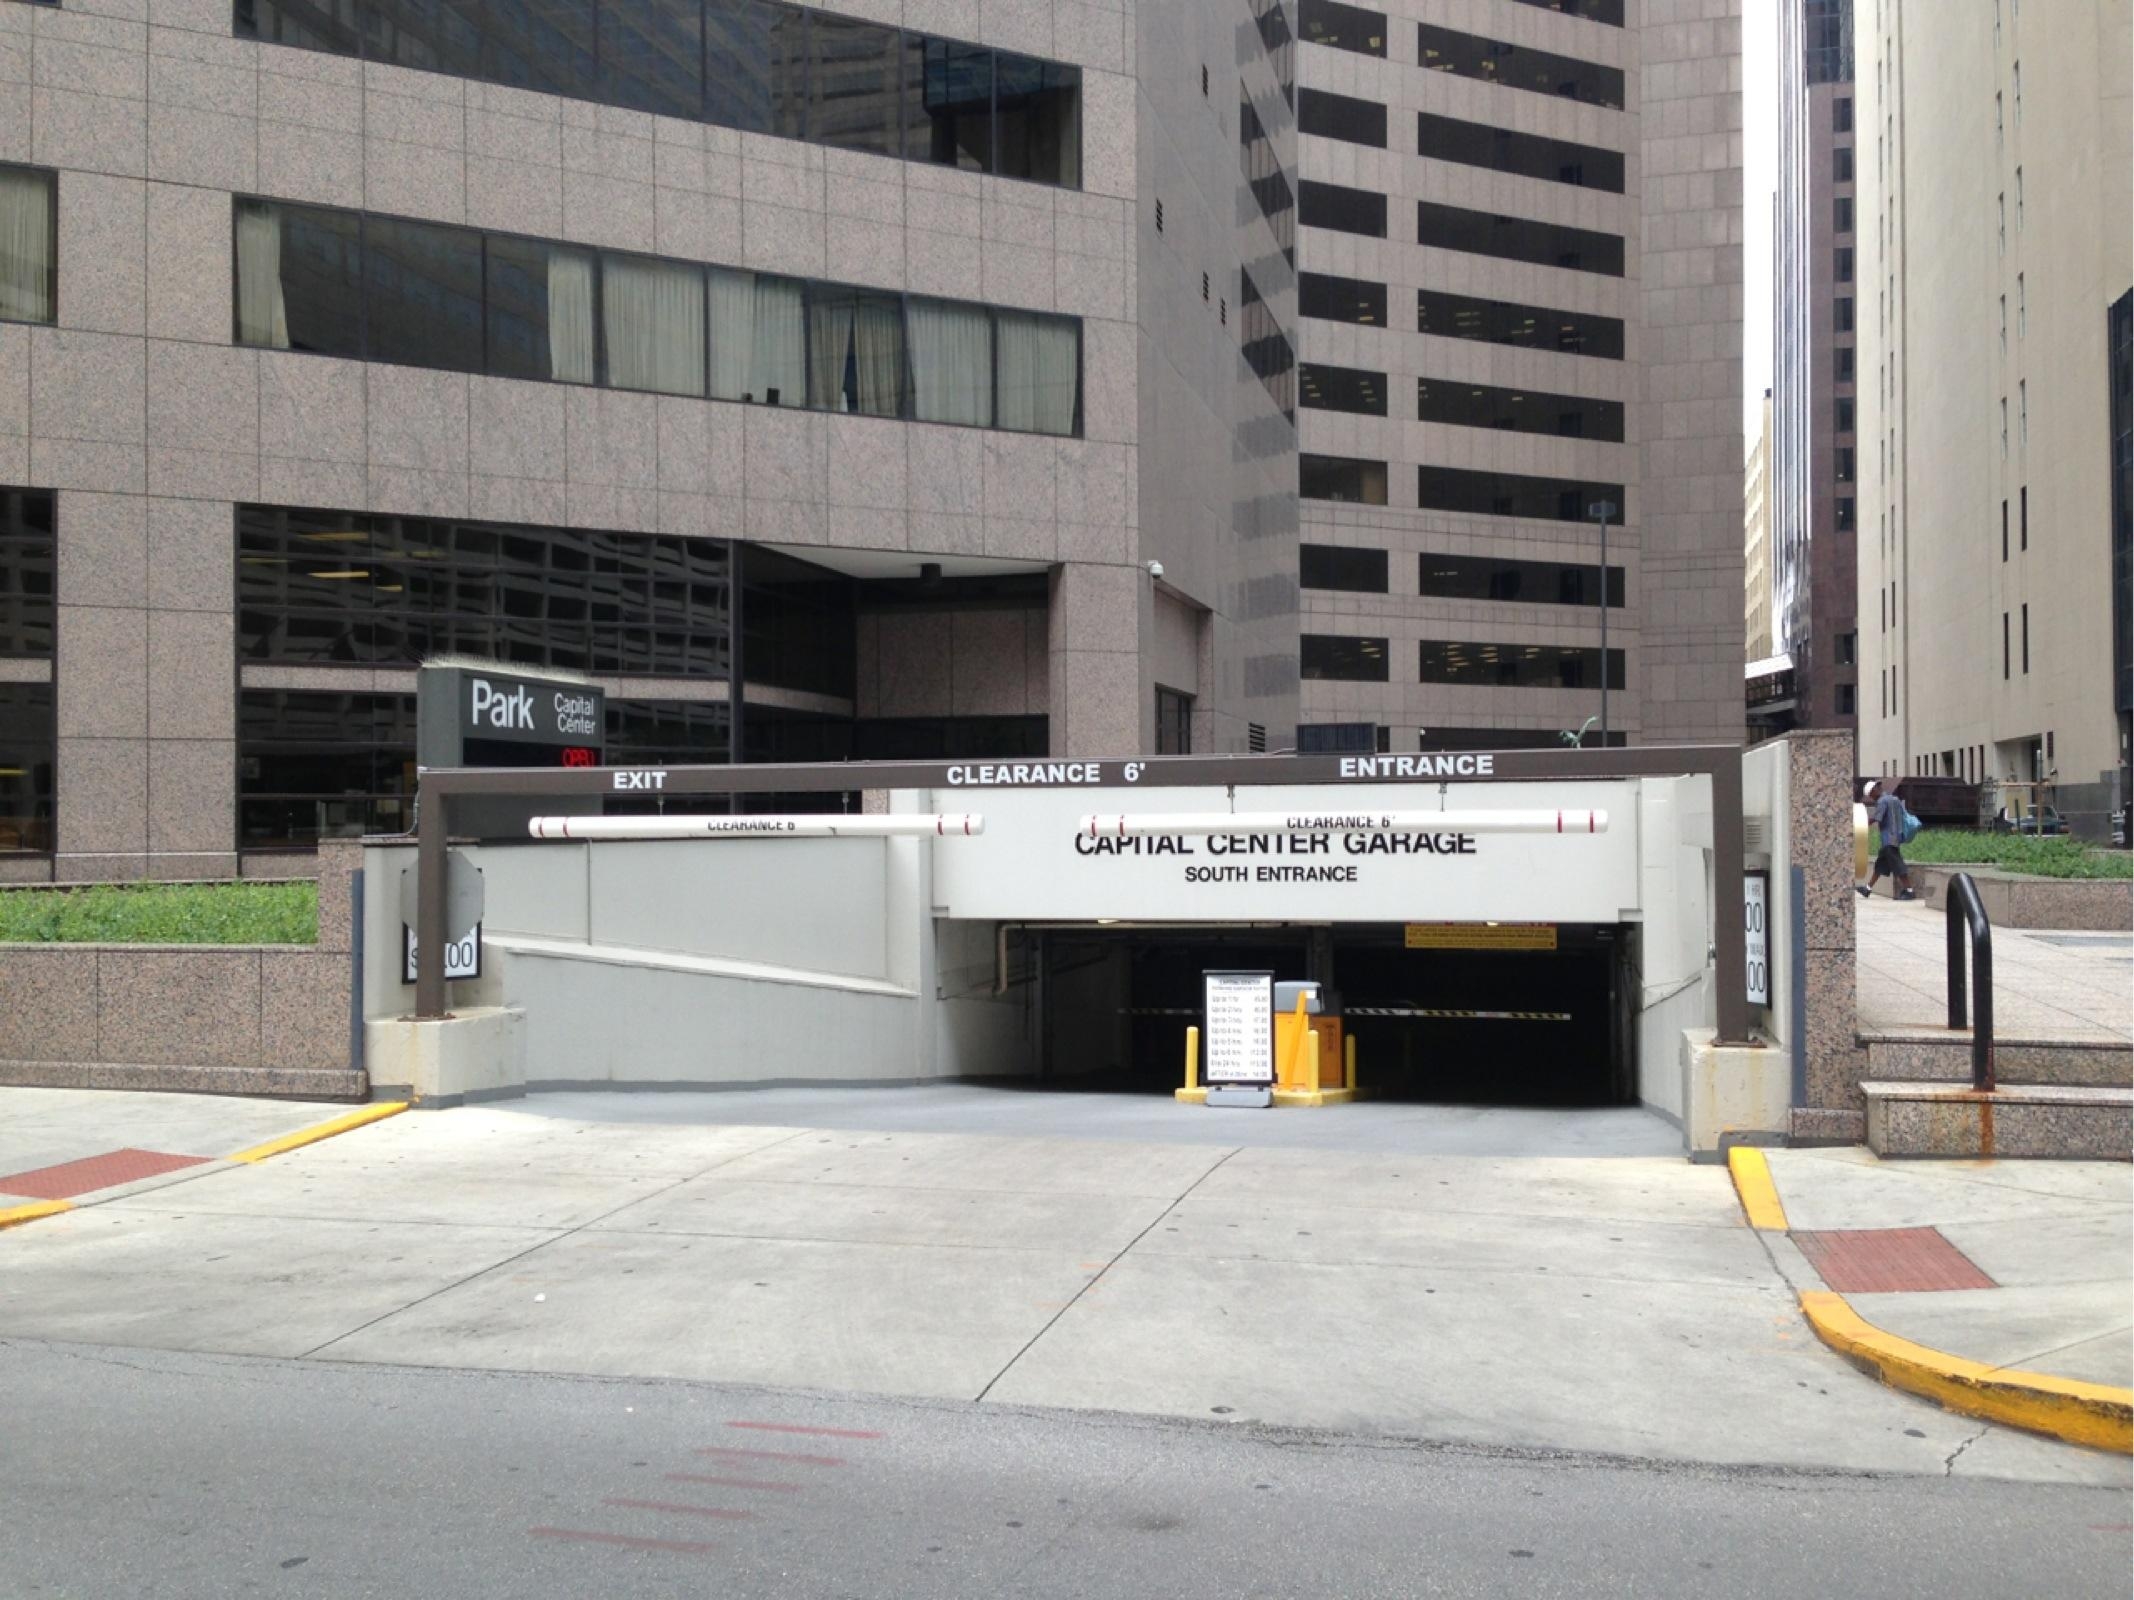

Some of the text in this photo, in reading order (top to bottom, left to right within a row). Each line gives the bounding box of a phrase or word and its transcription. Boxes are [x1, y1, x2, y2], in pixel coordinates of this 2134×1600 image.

[472, 678, 535, 729] Park
[554, 692, 594, 717] Capital
[557, 711, 595, 734] Center
[946, 762, 1146, 785] CLEARANCE 6'
[1340, 754, 1494, 778] ENTRANCE
[613, 771, 668, 790] EXIT
[1286, 815, 1375, 829] CLEARANCE
[1074, 832, 1477, 856] CAPITAL CENTER GARAGE
[1185, 866, 1358, 883] SOUTH ENTRANCE
